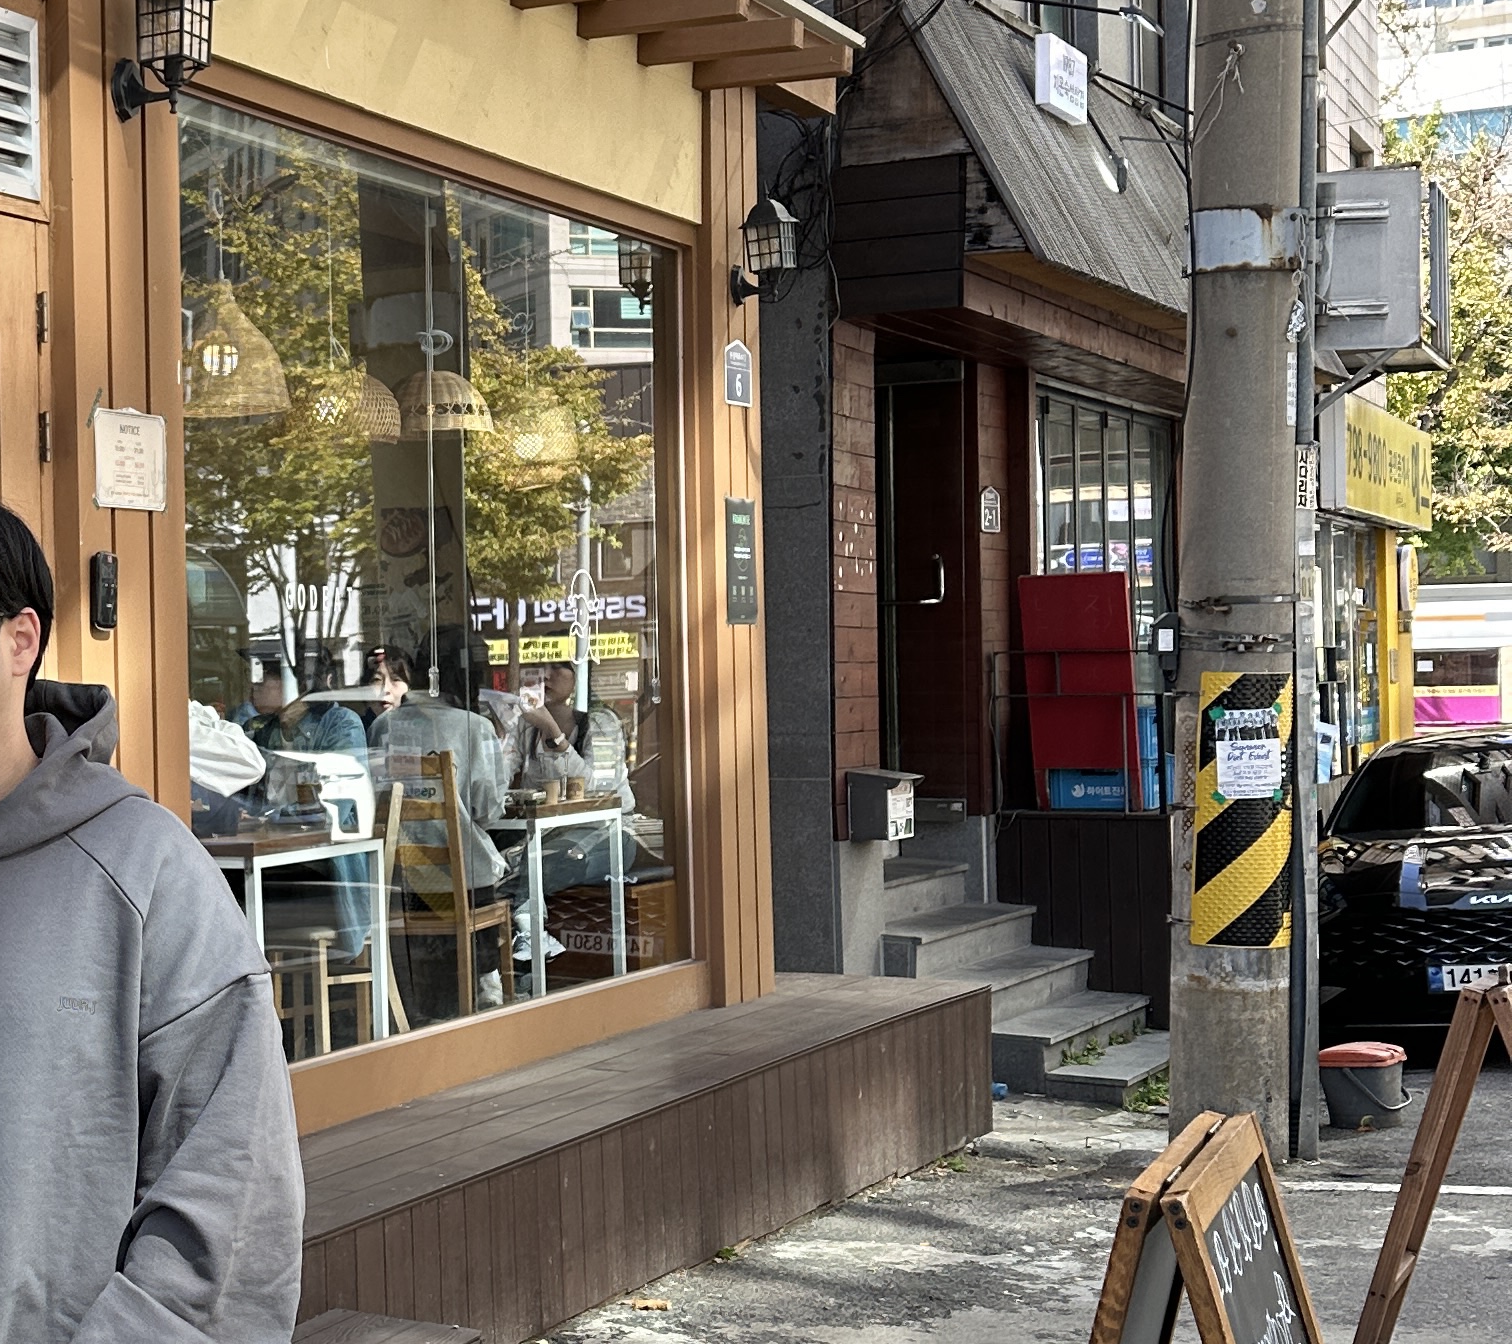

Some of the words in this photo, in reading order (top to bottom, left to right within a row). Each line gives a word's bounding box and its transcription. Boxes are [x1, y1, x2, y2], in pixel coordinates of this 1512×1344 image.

[735, 373, 743, 398] 6
[119, 424, 141, 436] NOTICE
[1086, 786, 1126, 796] 하이트진
